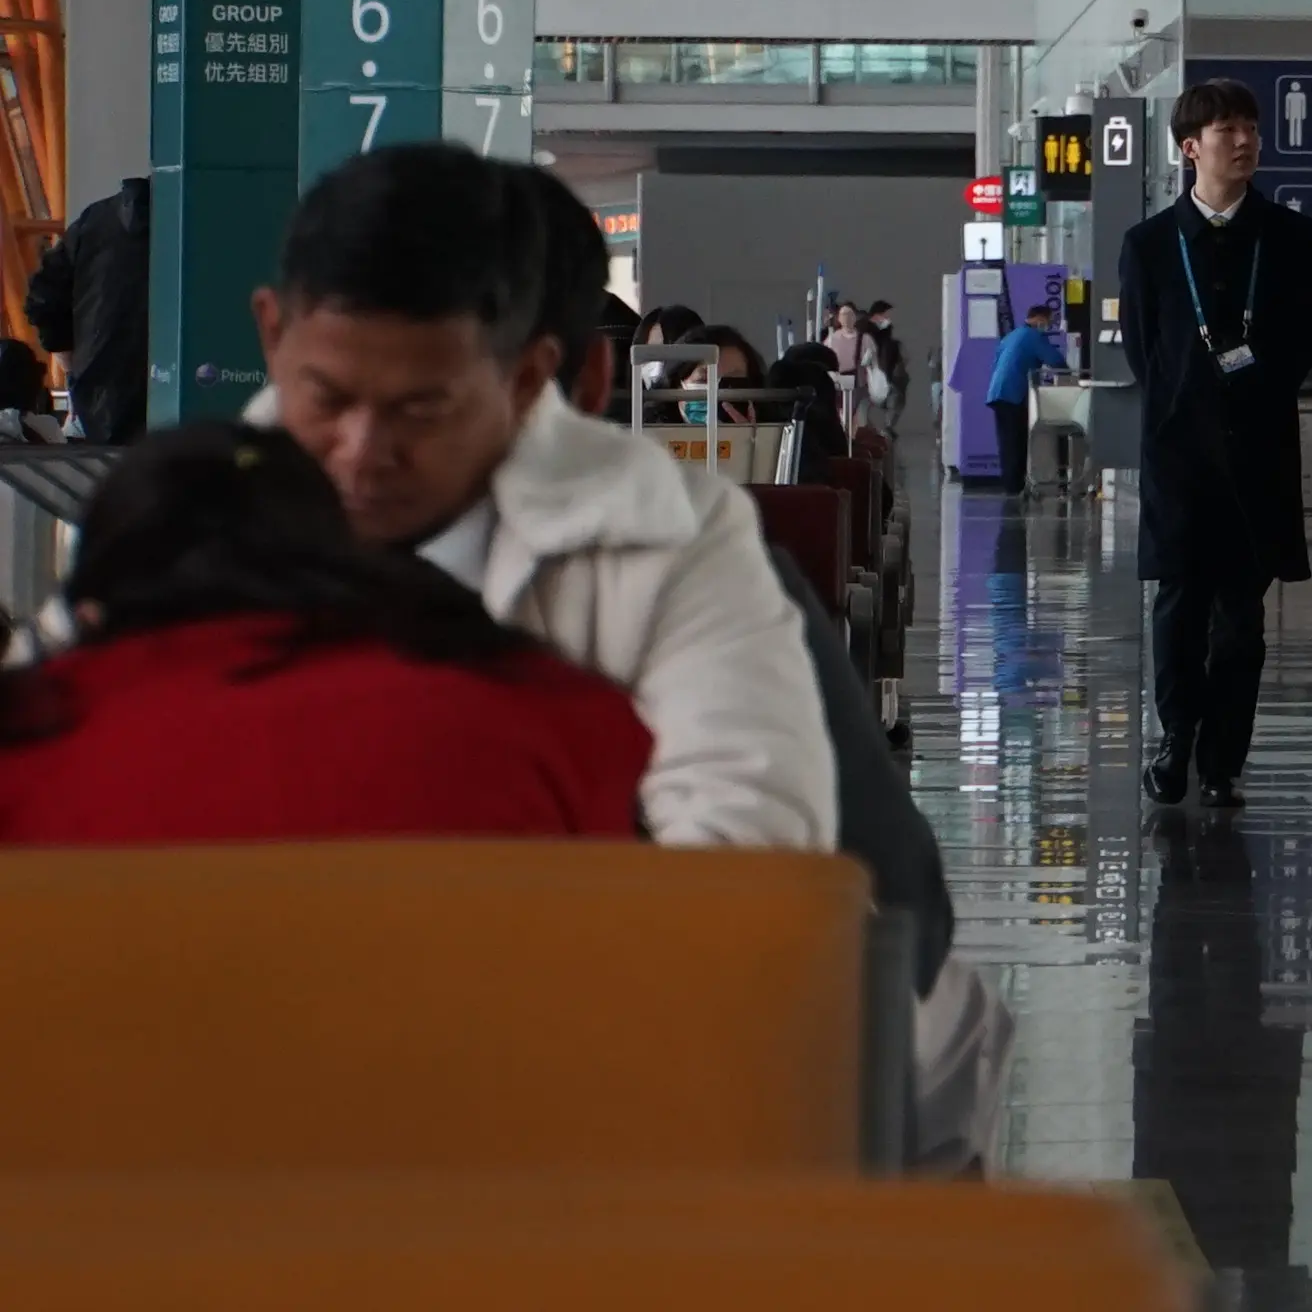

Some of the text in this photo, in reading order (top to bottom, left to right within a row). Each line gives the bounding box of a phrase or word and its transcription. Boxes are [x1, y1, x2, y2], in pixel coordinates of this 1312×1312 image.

[211, 4, 283, 22] GROUP
[204, 62, 288, 84] 优先组别
[349, 95, 387, 155] 7
[475, 97, 501, 158] 7
